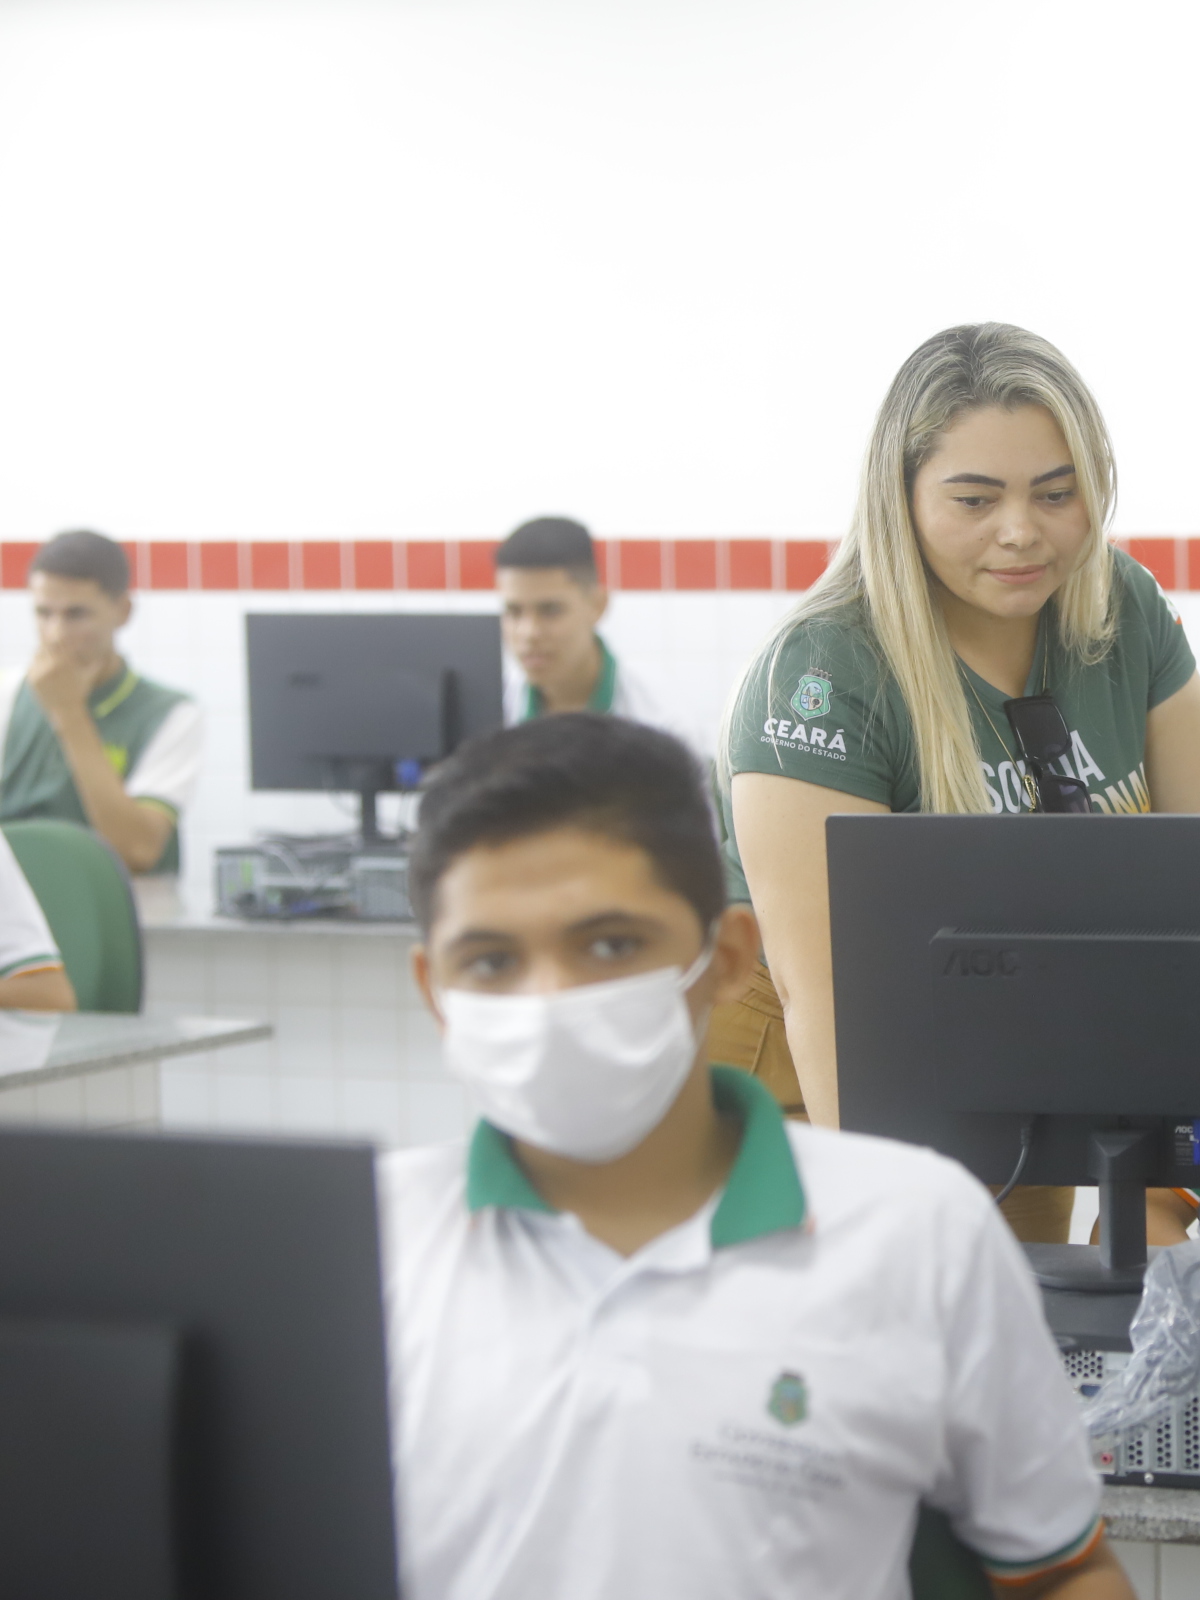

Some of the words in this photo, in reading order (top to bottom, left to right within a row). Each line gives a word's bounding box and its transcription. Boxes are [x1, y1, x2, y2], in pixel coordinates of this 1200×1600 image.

[760, 736, 796, 749] GOVERNO
[797, 743, 811, 752] DO
[812, 747, 846, 761] ESTADO
[763, 718, 847, 754] CEARÁ
[942, 947, 1021, 977] AOC
